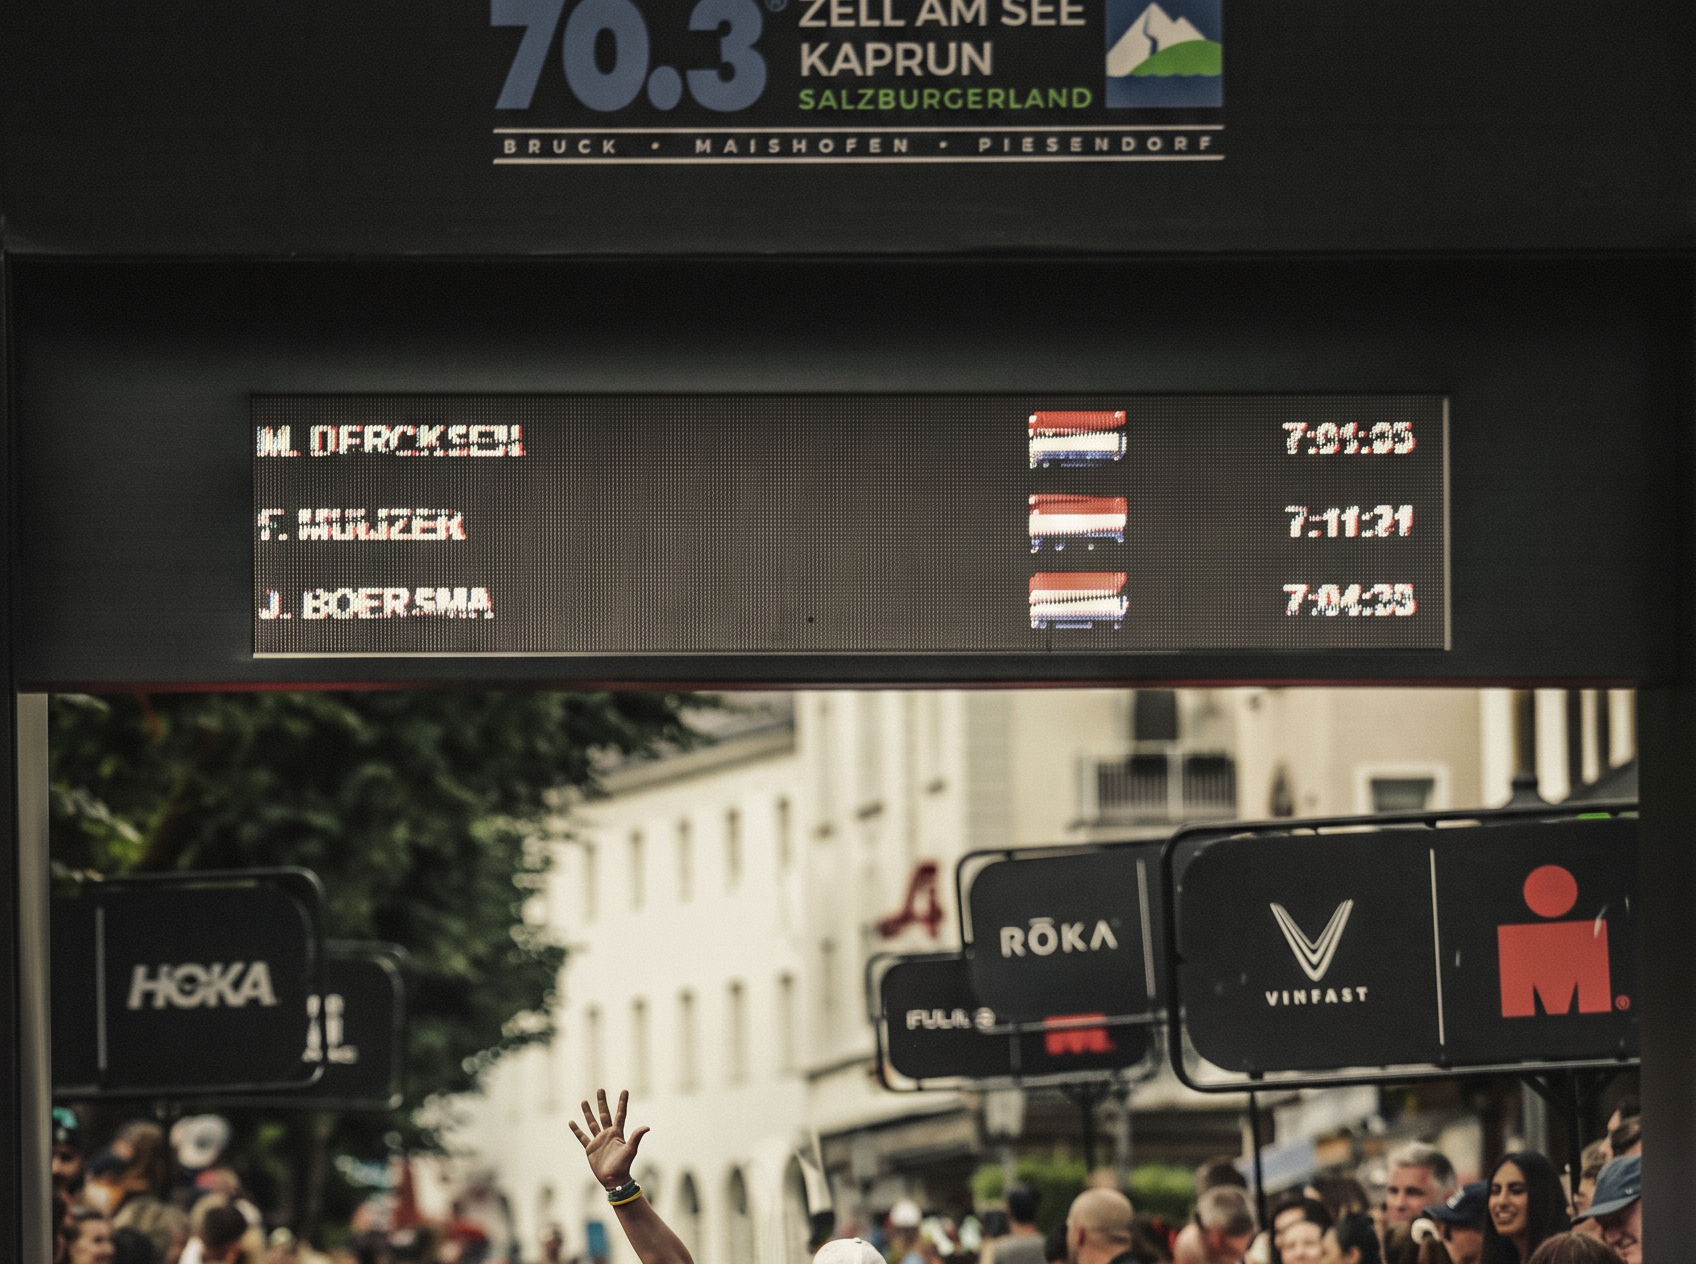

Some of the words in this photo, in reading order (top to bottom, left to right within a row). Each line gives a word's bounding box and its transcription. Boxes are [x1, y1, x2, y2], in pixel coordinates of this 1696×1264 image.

[799, 0, 906, 27] ZELL
[915, 0, 986, 26] AM
[1001, 0, 1085, 26] SEE
[489, 0, 767, 112] 70.3
[801, 42, 992, 77] KAPRUN
[799, 88, 1092, 110] SALZBURGERLAND
[503, 139, 616, 154] BRUCK
[695, 138, 909, 153] MAISHOFEN
[978, 136, 1213, 152] PIESENDORF
[301, 587, 495, 620] BOERSMA
[127, 962, 277, 1010] HOKA
[1265, 986, 1368, 1006] VINFAST
